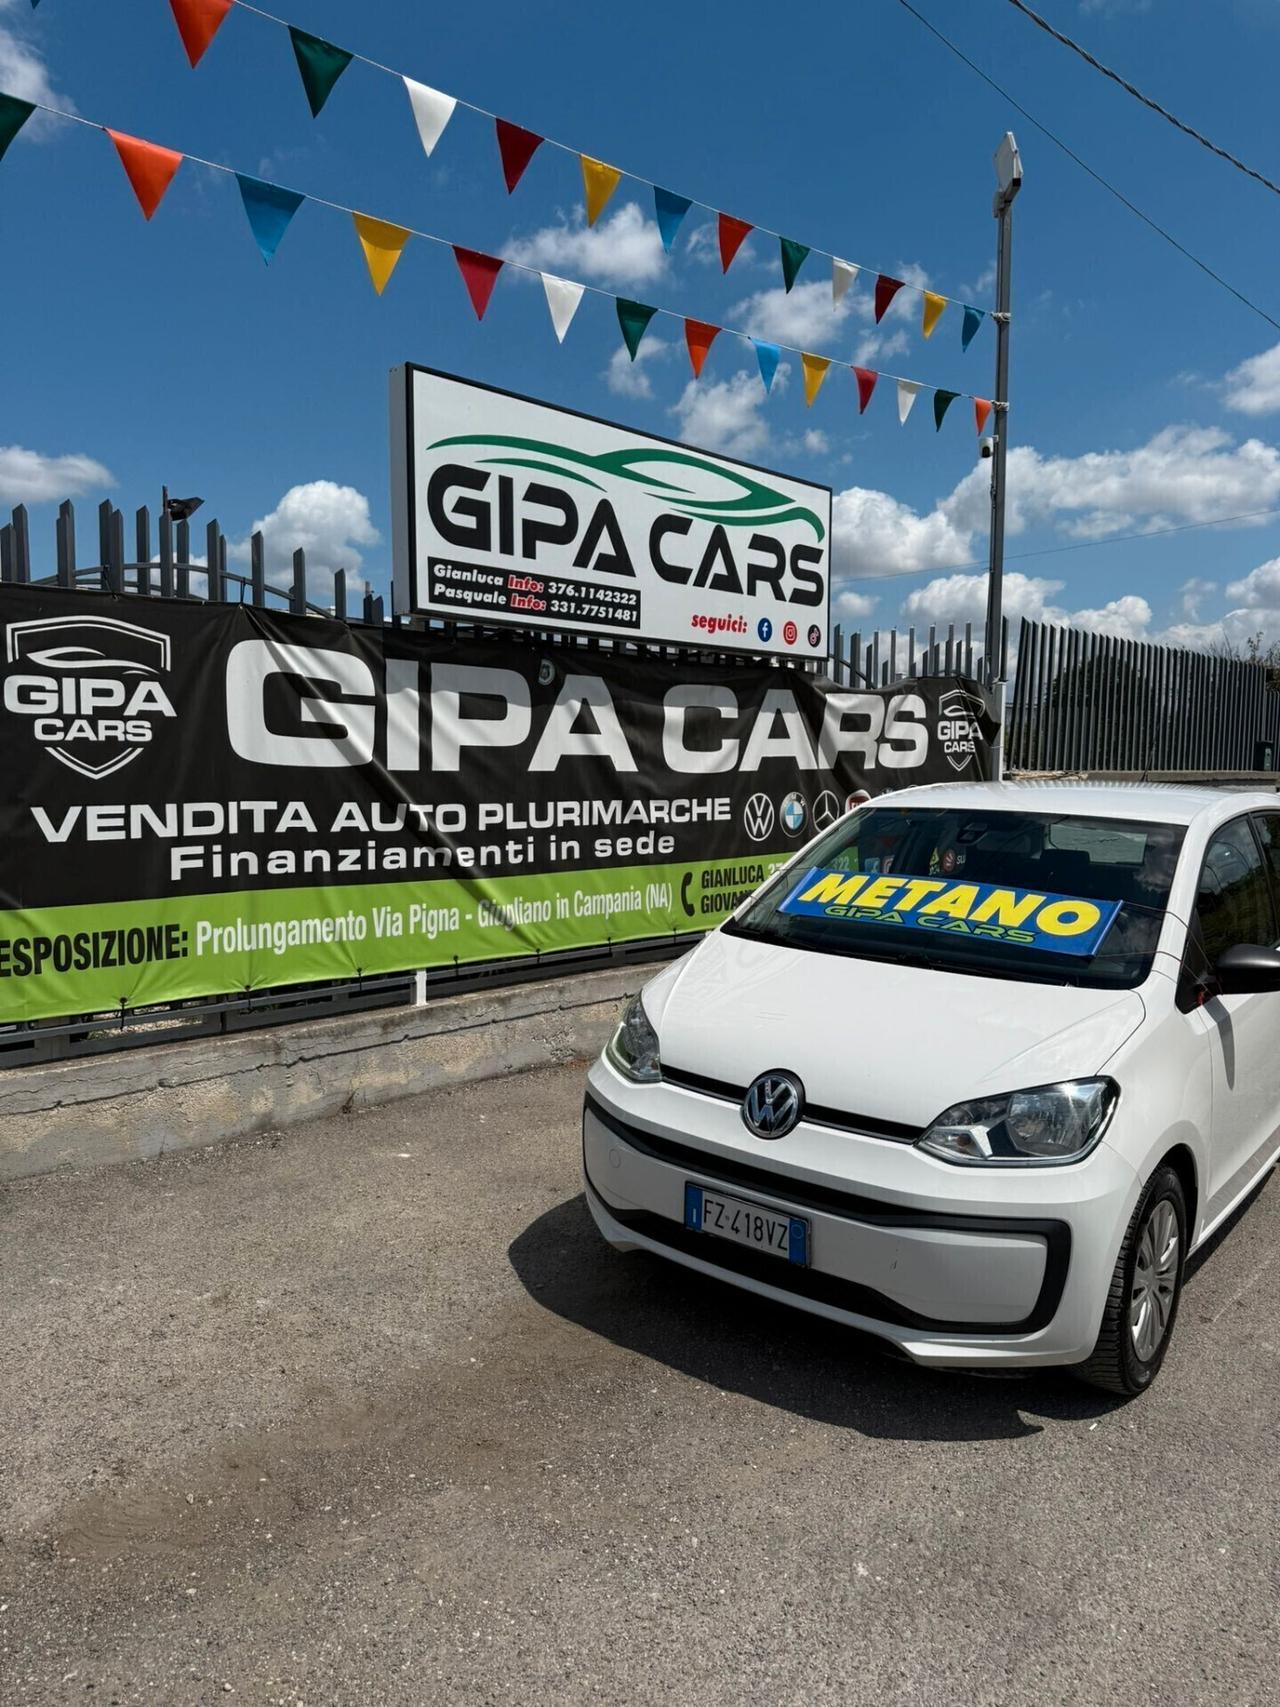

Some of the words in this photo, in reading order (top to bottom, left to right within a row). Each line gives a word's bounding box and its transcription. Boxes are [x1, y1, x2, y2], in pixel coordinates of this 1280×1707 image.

[427, 463, 637, 578] GIPA
[648, 514, 825, 607] CARS
[433, 564, 504, 586] Gianluca
[508, 574, 545, 593] Info:
[547, 581, 638, 606] 376.1142322
[434, 583, 507, 606] Pasquale
[509, 593, 547, 612] Info:
[550, 600, 638, 622] 331.7751481
[691, 613, 748, 634] seguici:
[3, 674, 178, 718] GIPA
[226, 638, 639, 773] GIPA
[661, 684, 929, 774] CARS
[33, 718, 153, 742] CARS
[937, 720, 984, 740] GIPA
[944, 741, 976, 753] CARS
[30, 801, 317, 843] VENDITA
[330, 802, 467, 833] AUTO
[478, 797, 732, 830] PLURIMARCHE
[170, 836, 535, 881] Finanziamenti
[549, 834, 581, 861] in
[594, 830, 675, 858] sede
[701, 864, 764, 889] GIANLUCA
[196, 906, 367, 956] Prolungamento
[372, 907, 402, 938] Via
[409, 903, 460, 939] Pigna
[478, 896, 551, 932] Giugliano
[556, 893, 569, 919] in
[574, 885, 642, 919] Campania
[646, 883, 672, 914] (NA)
[798, 873, 1101, 936] METANO
[824, 905, 904, 924] GIPA
[916, 915, 1036, 943] CARS
[0, 923, 188, 978] ESPOSIZIONE:
